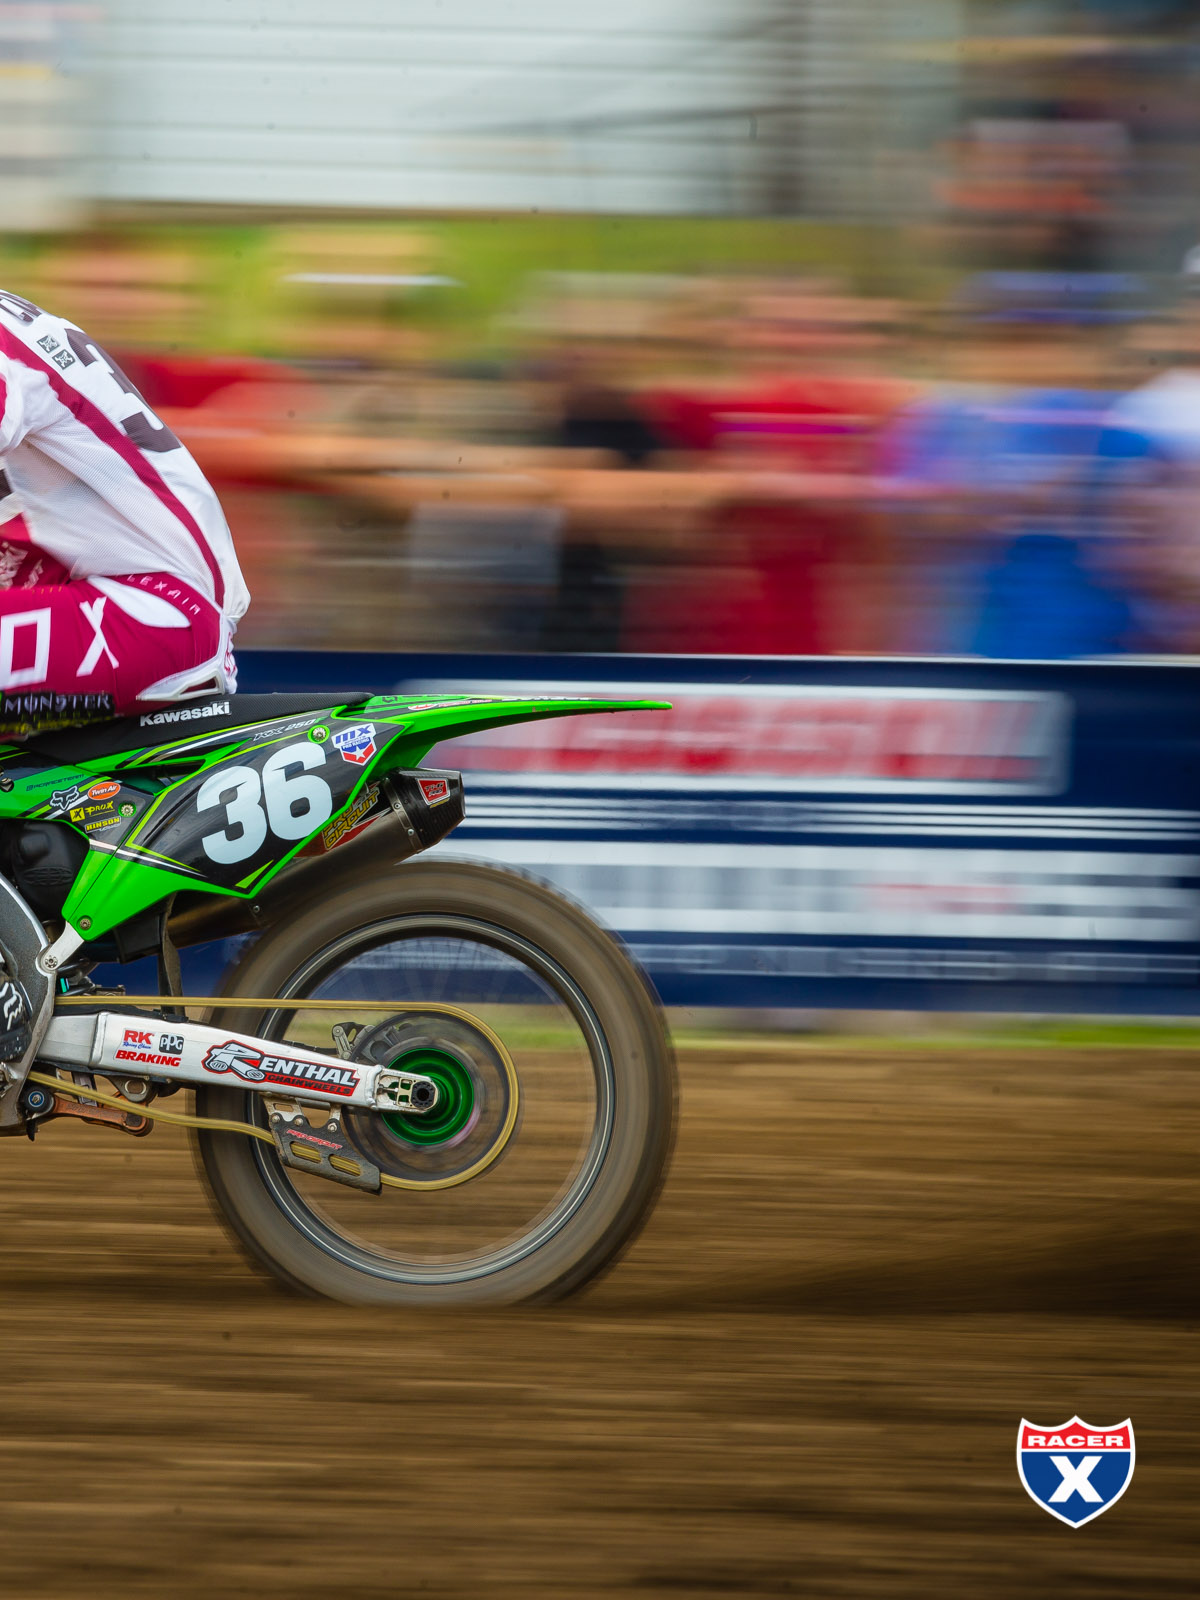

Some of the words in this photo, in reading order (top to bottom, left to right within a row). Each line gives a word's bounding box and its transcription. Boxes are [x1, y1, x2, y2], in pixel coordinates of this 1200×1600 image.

[139, 701, 231, 727] Kawasaki
[253, 727, 286, 742] KX
[91, 789, 107, 797] Twin
[196, 741, 333, 865] 36
[86, 817, 120, 832] HINSON
[325, 791, 379, 848] CIRCUIT
[124, 1030, 152, 1044] RK
[116, 1049, 182, 1067] BRAKING
[207, 1042, 356, 1087] RENTHAL
[267, 1074, 351, 1095] CHAINWHEELS
